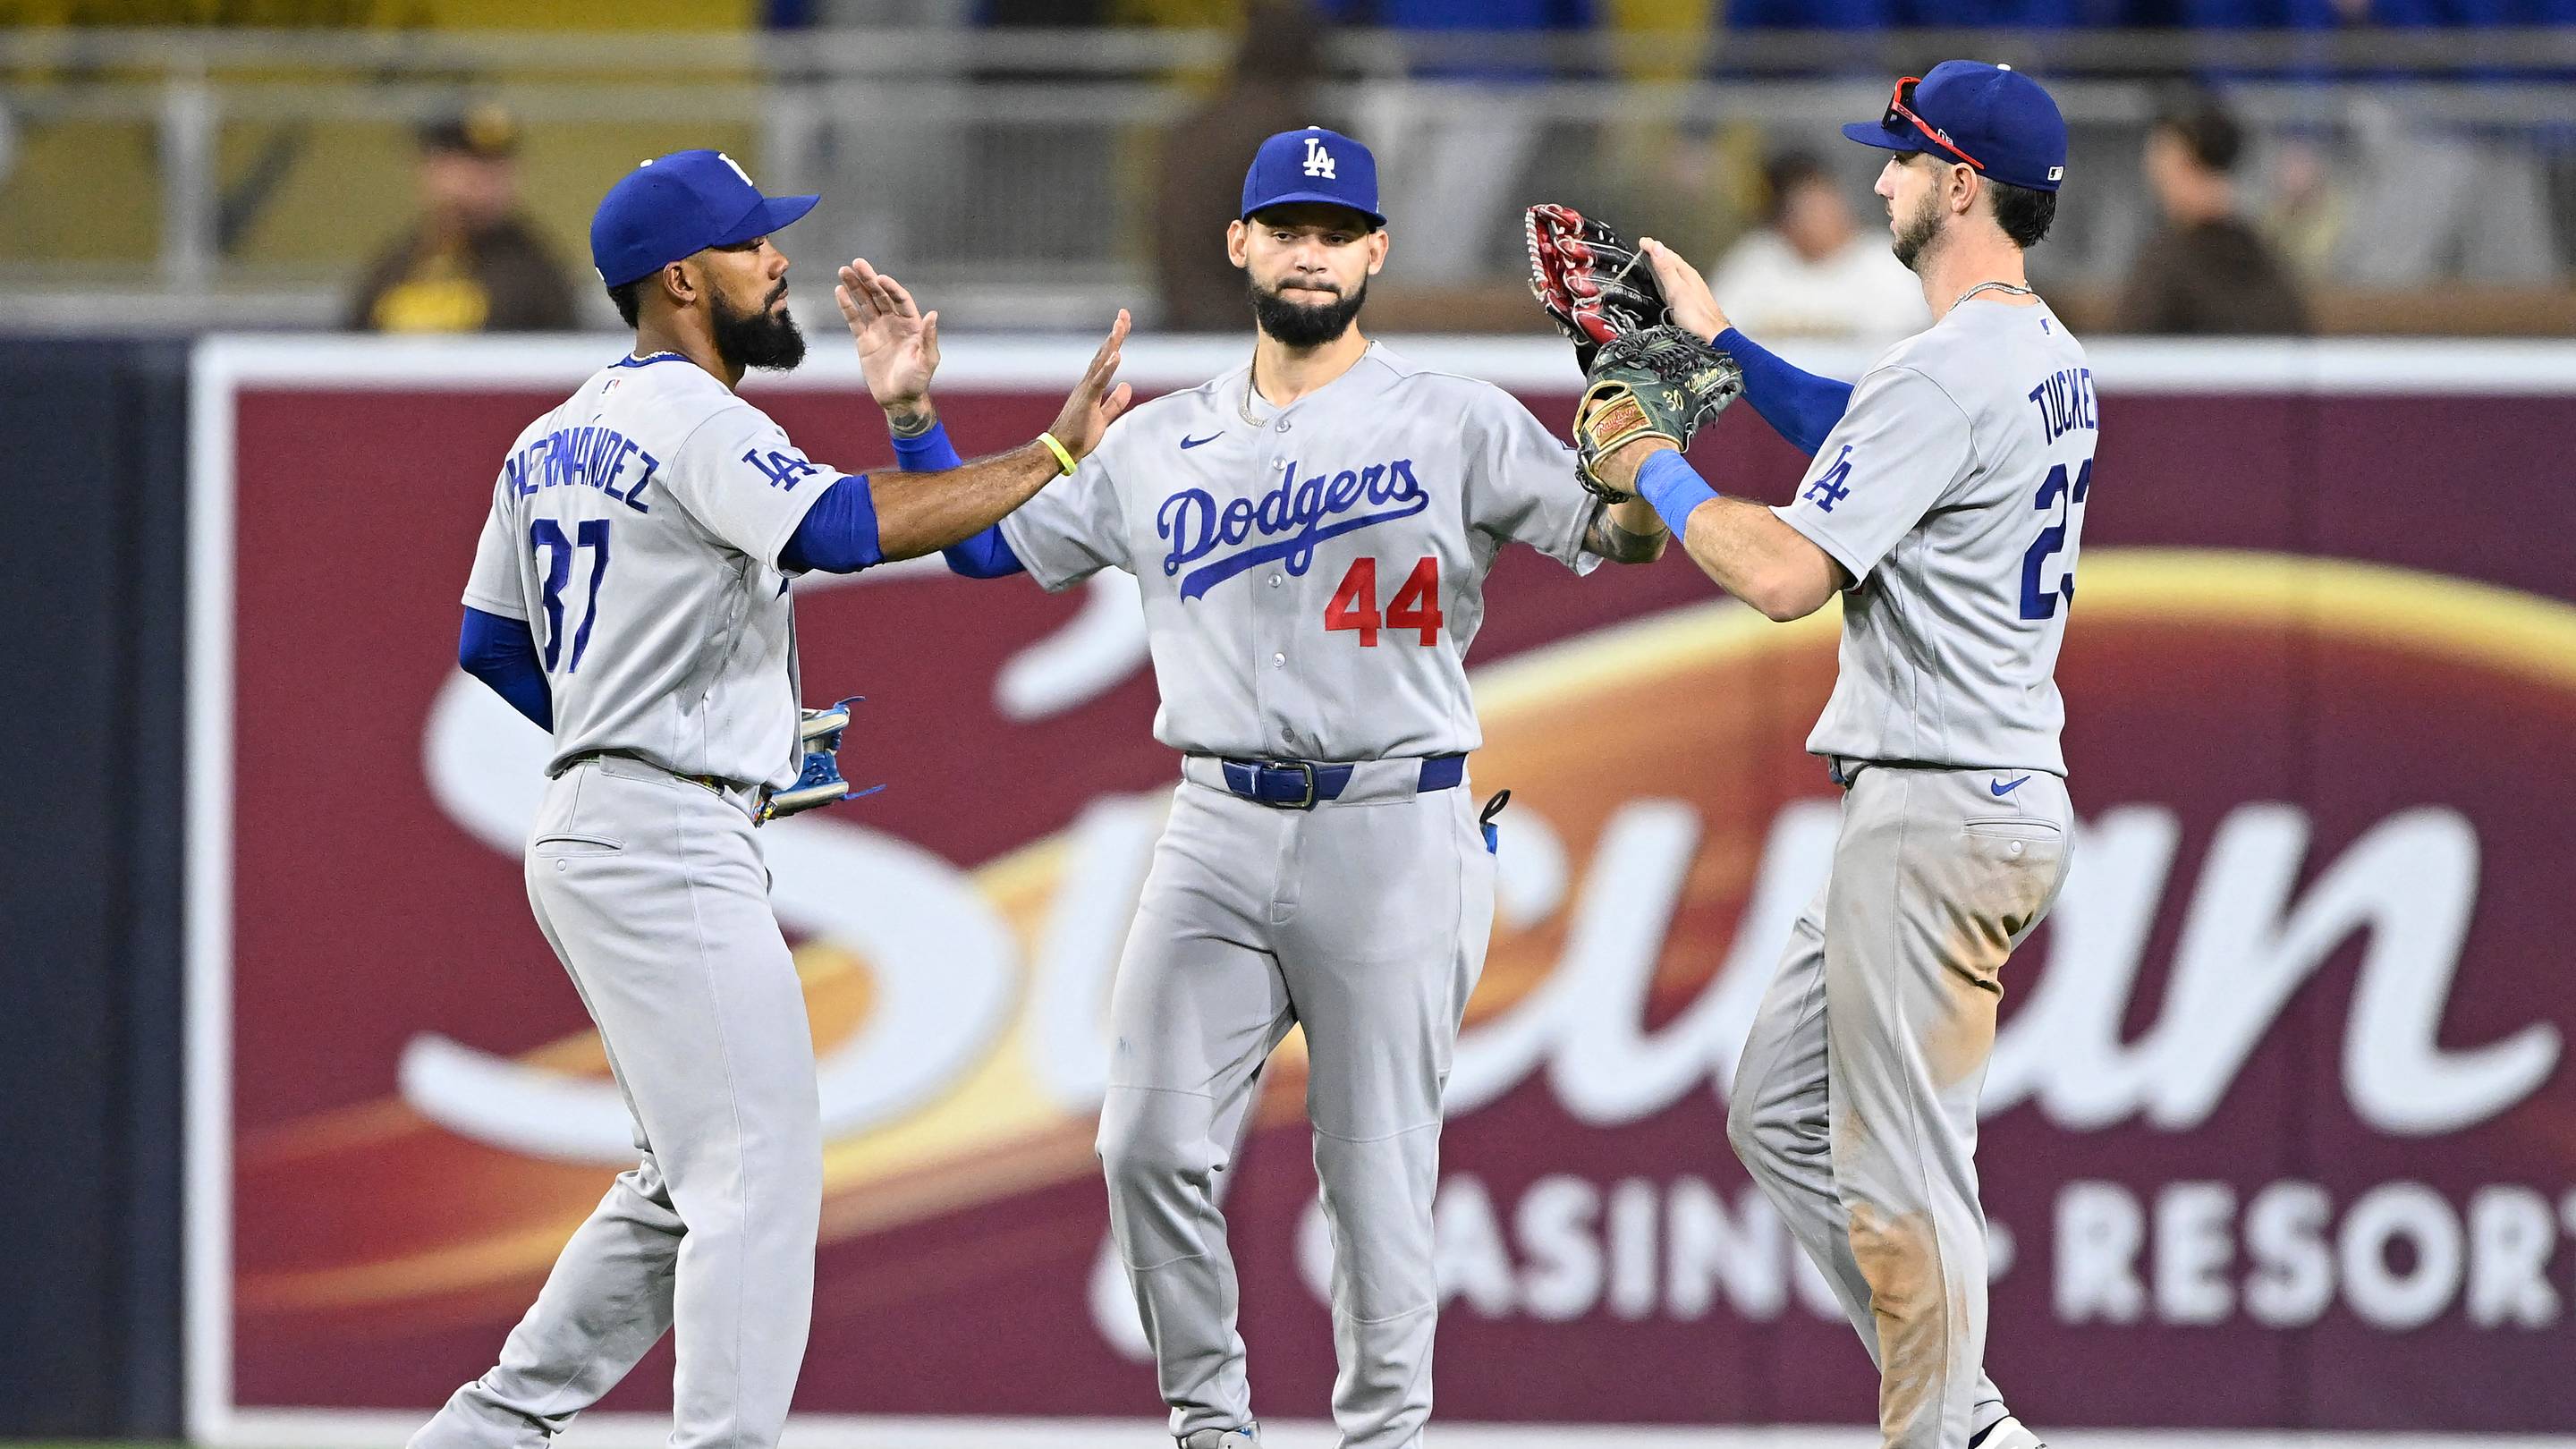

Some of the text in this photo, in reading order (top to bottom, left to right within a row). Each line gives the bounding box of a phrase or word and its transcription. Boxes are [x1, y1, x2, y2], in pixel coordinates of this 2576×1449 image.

[1302, 138, 1336, 180] LA
[1662, 389, 1684, 412] 30
[2029, 368, 2098, 446] TUCKE
[741, 448, 818, 492] LA
[1802, 445, 1853, 513] LA
[1157, 459, 1429, 578] Dodgers
[530, 518, 610, 673] 37
[1325, 556, 1443, 647] 44
[1296, 1173, 2576, 1332] ASIN RESOR
